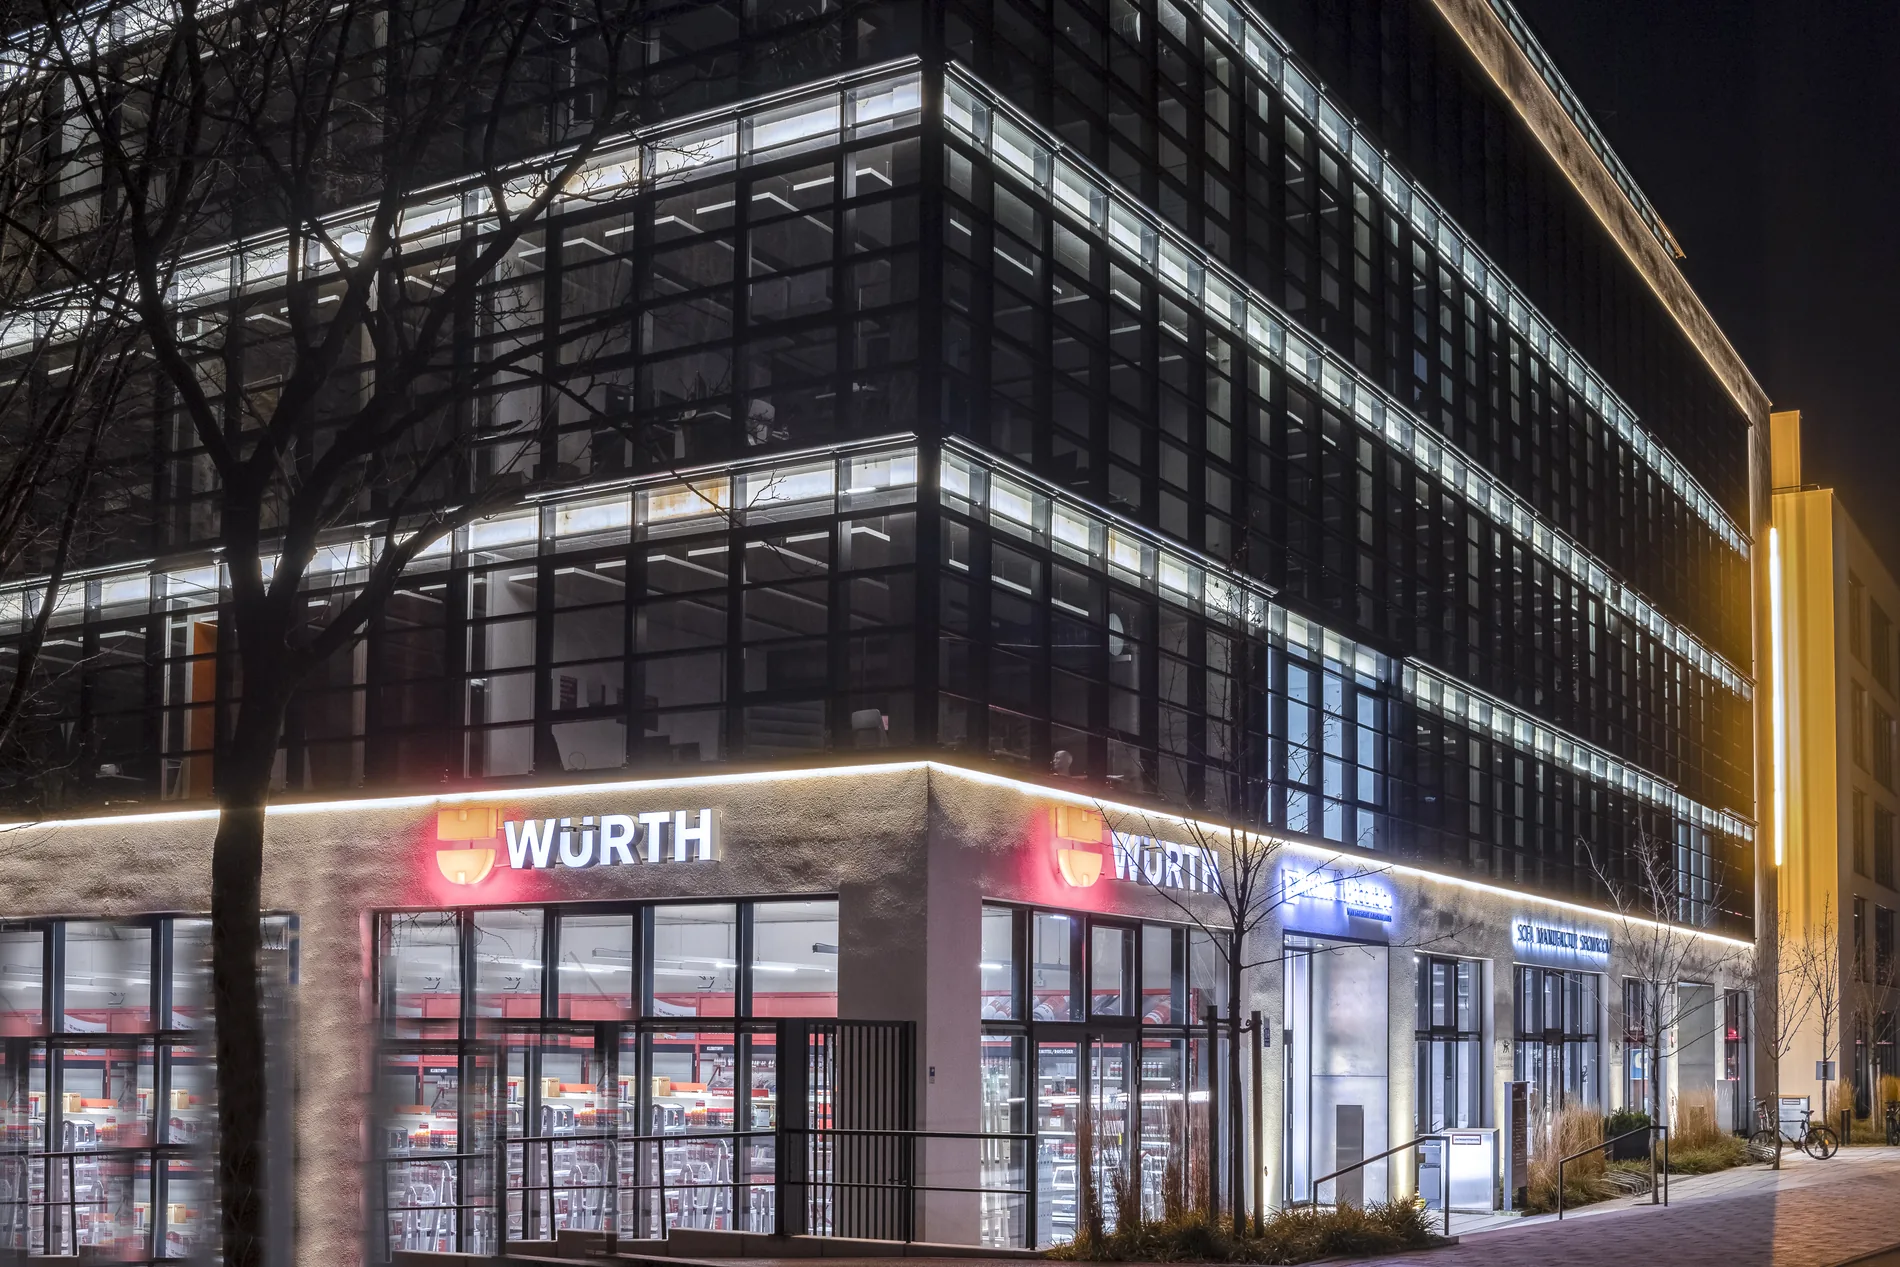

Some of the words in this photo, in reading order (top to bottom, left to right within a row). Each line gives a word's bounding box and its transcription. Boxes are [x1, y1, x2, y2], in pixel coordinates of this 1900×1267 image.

[504, 807, 713, 869] WÜRTH
[1111, 831, 1219, 894] WÜRTH
[1518, 924, 1534, 943] SOFA
[1580, 935, 1612, 953] SHOWROOM
